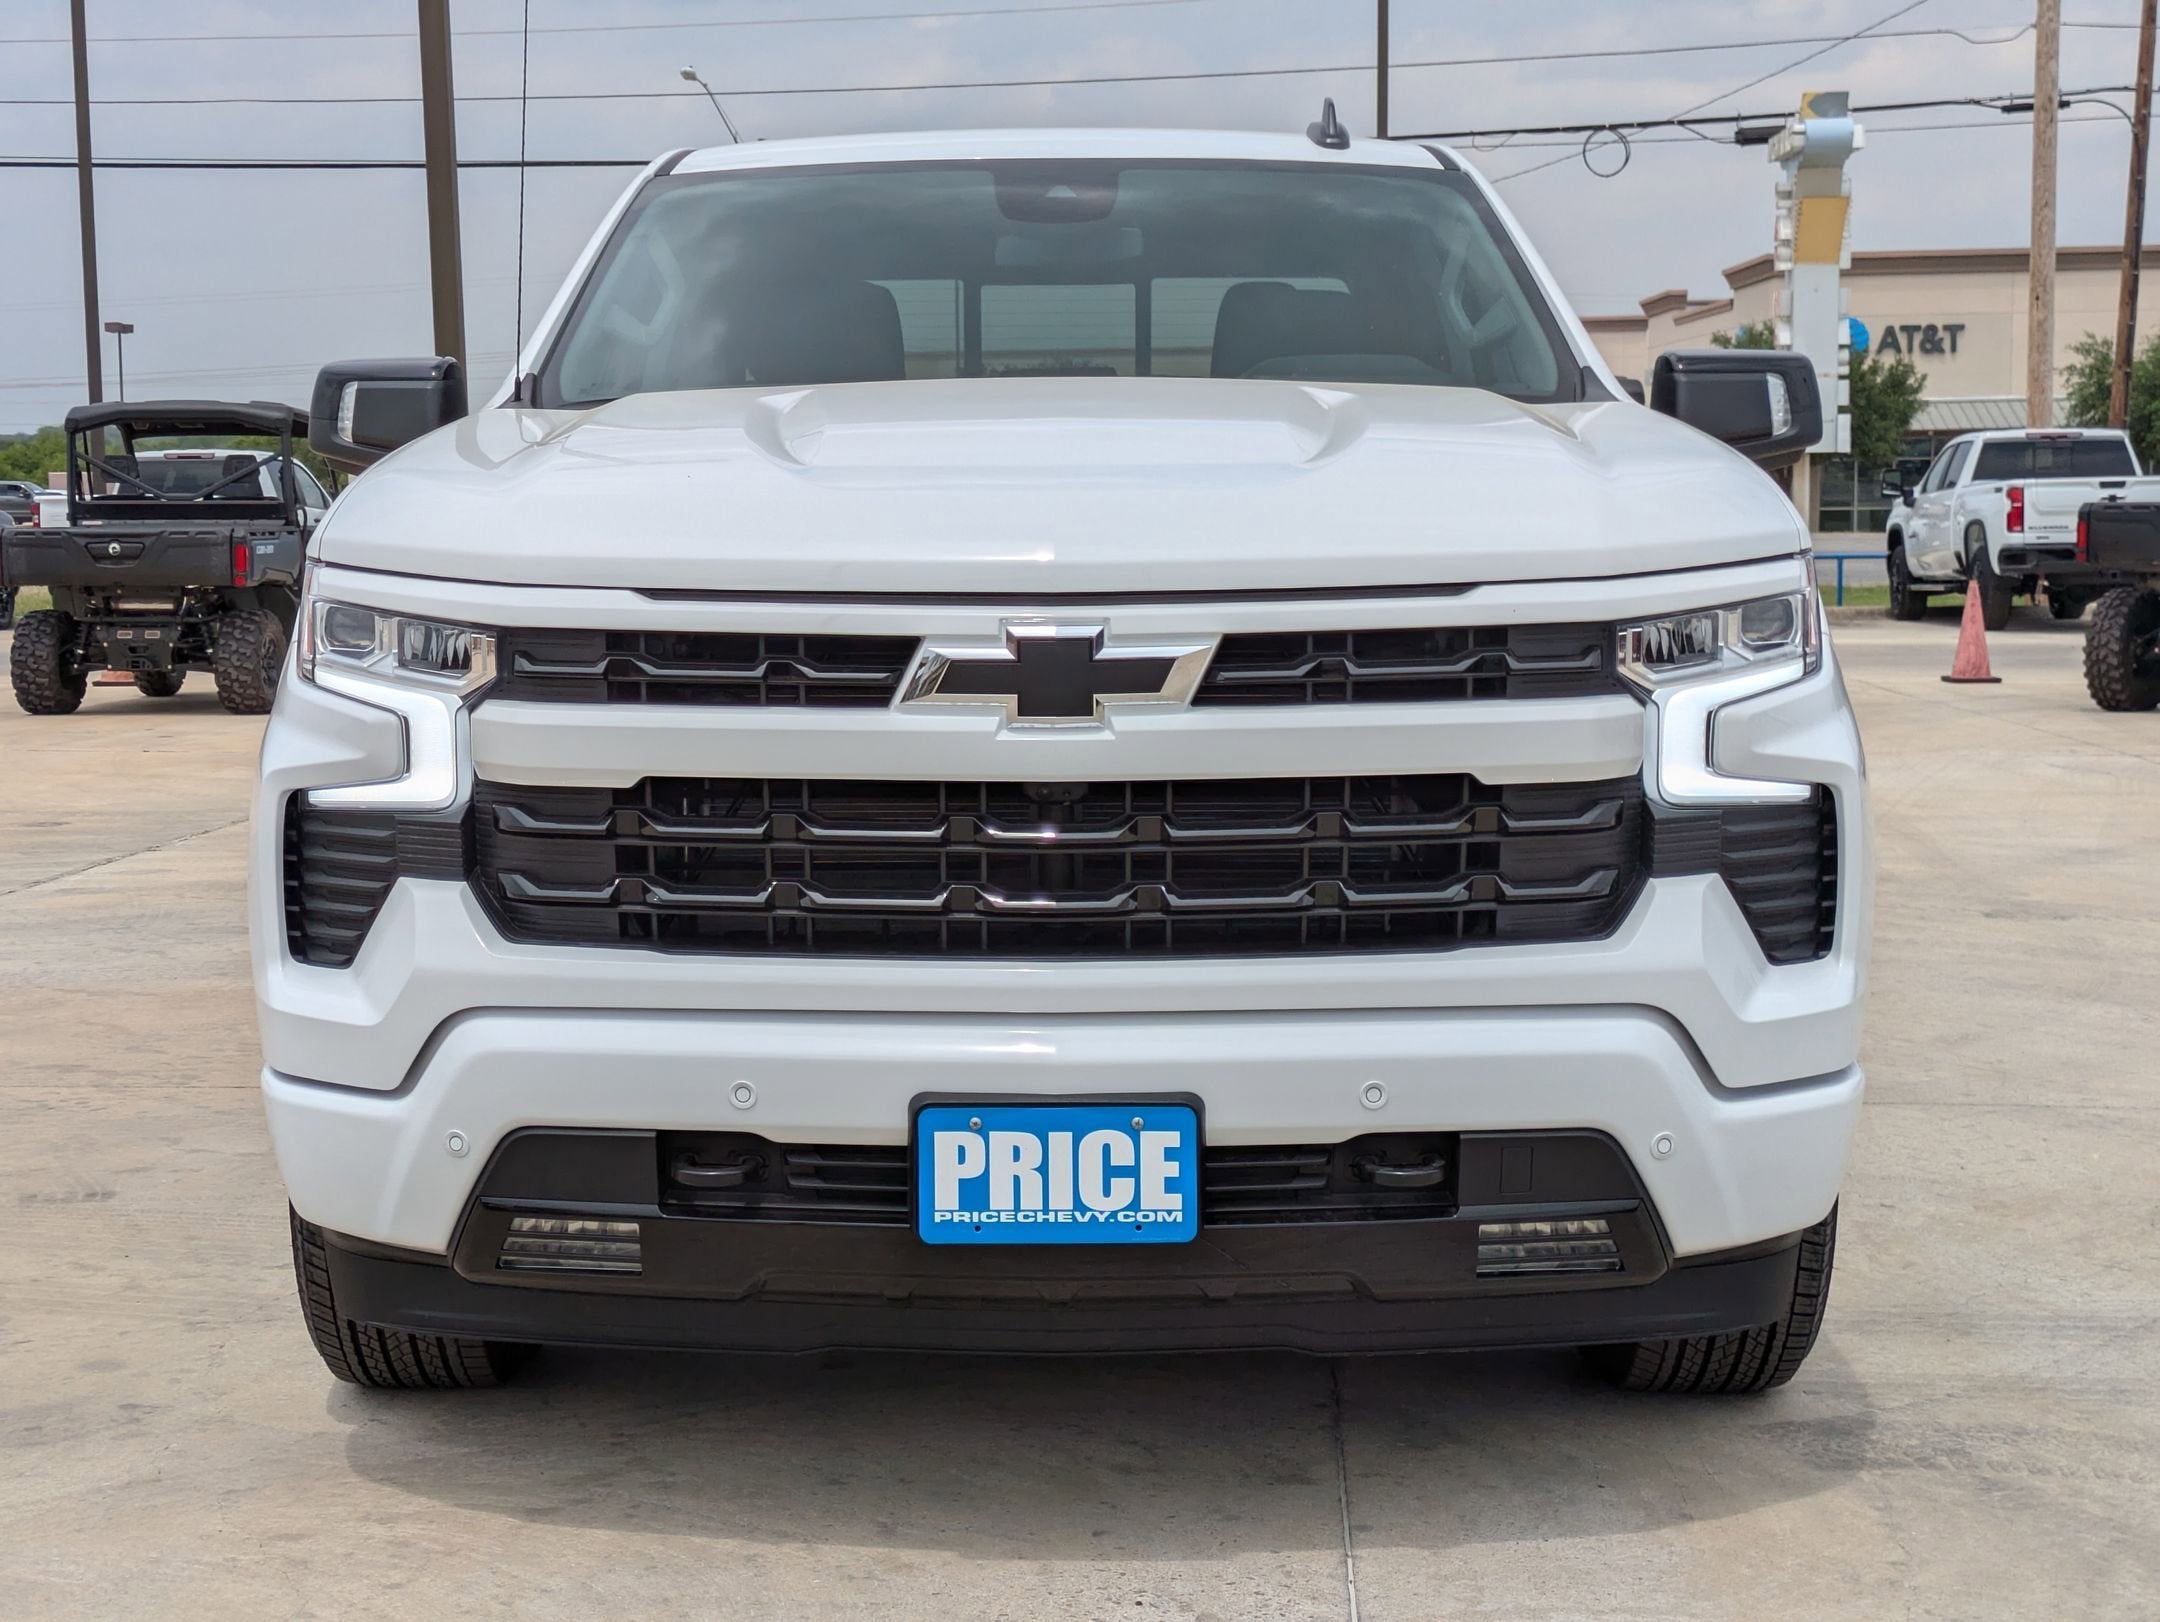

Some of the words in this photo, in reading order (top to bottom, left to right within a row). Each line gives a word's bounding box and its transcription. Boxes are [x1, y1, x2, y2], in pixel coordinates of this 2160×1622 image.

[1876, 323, 1965, 354] AT&T
[934, 1129, 1183, 1211] PRICE
[934, 1211, 1183, 1223] PRICECHEVY.COM
